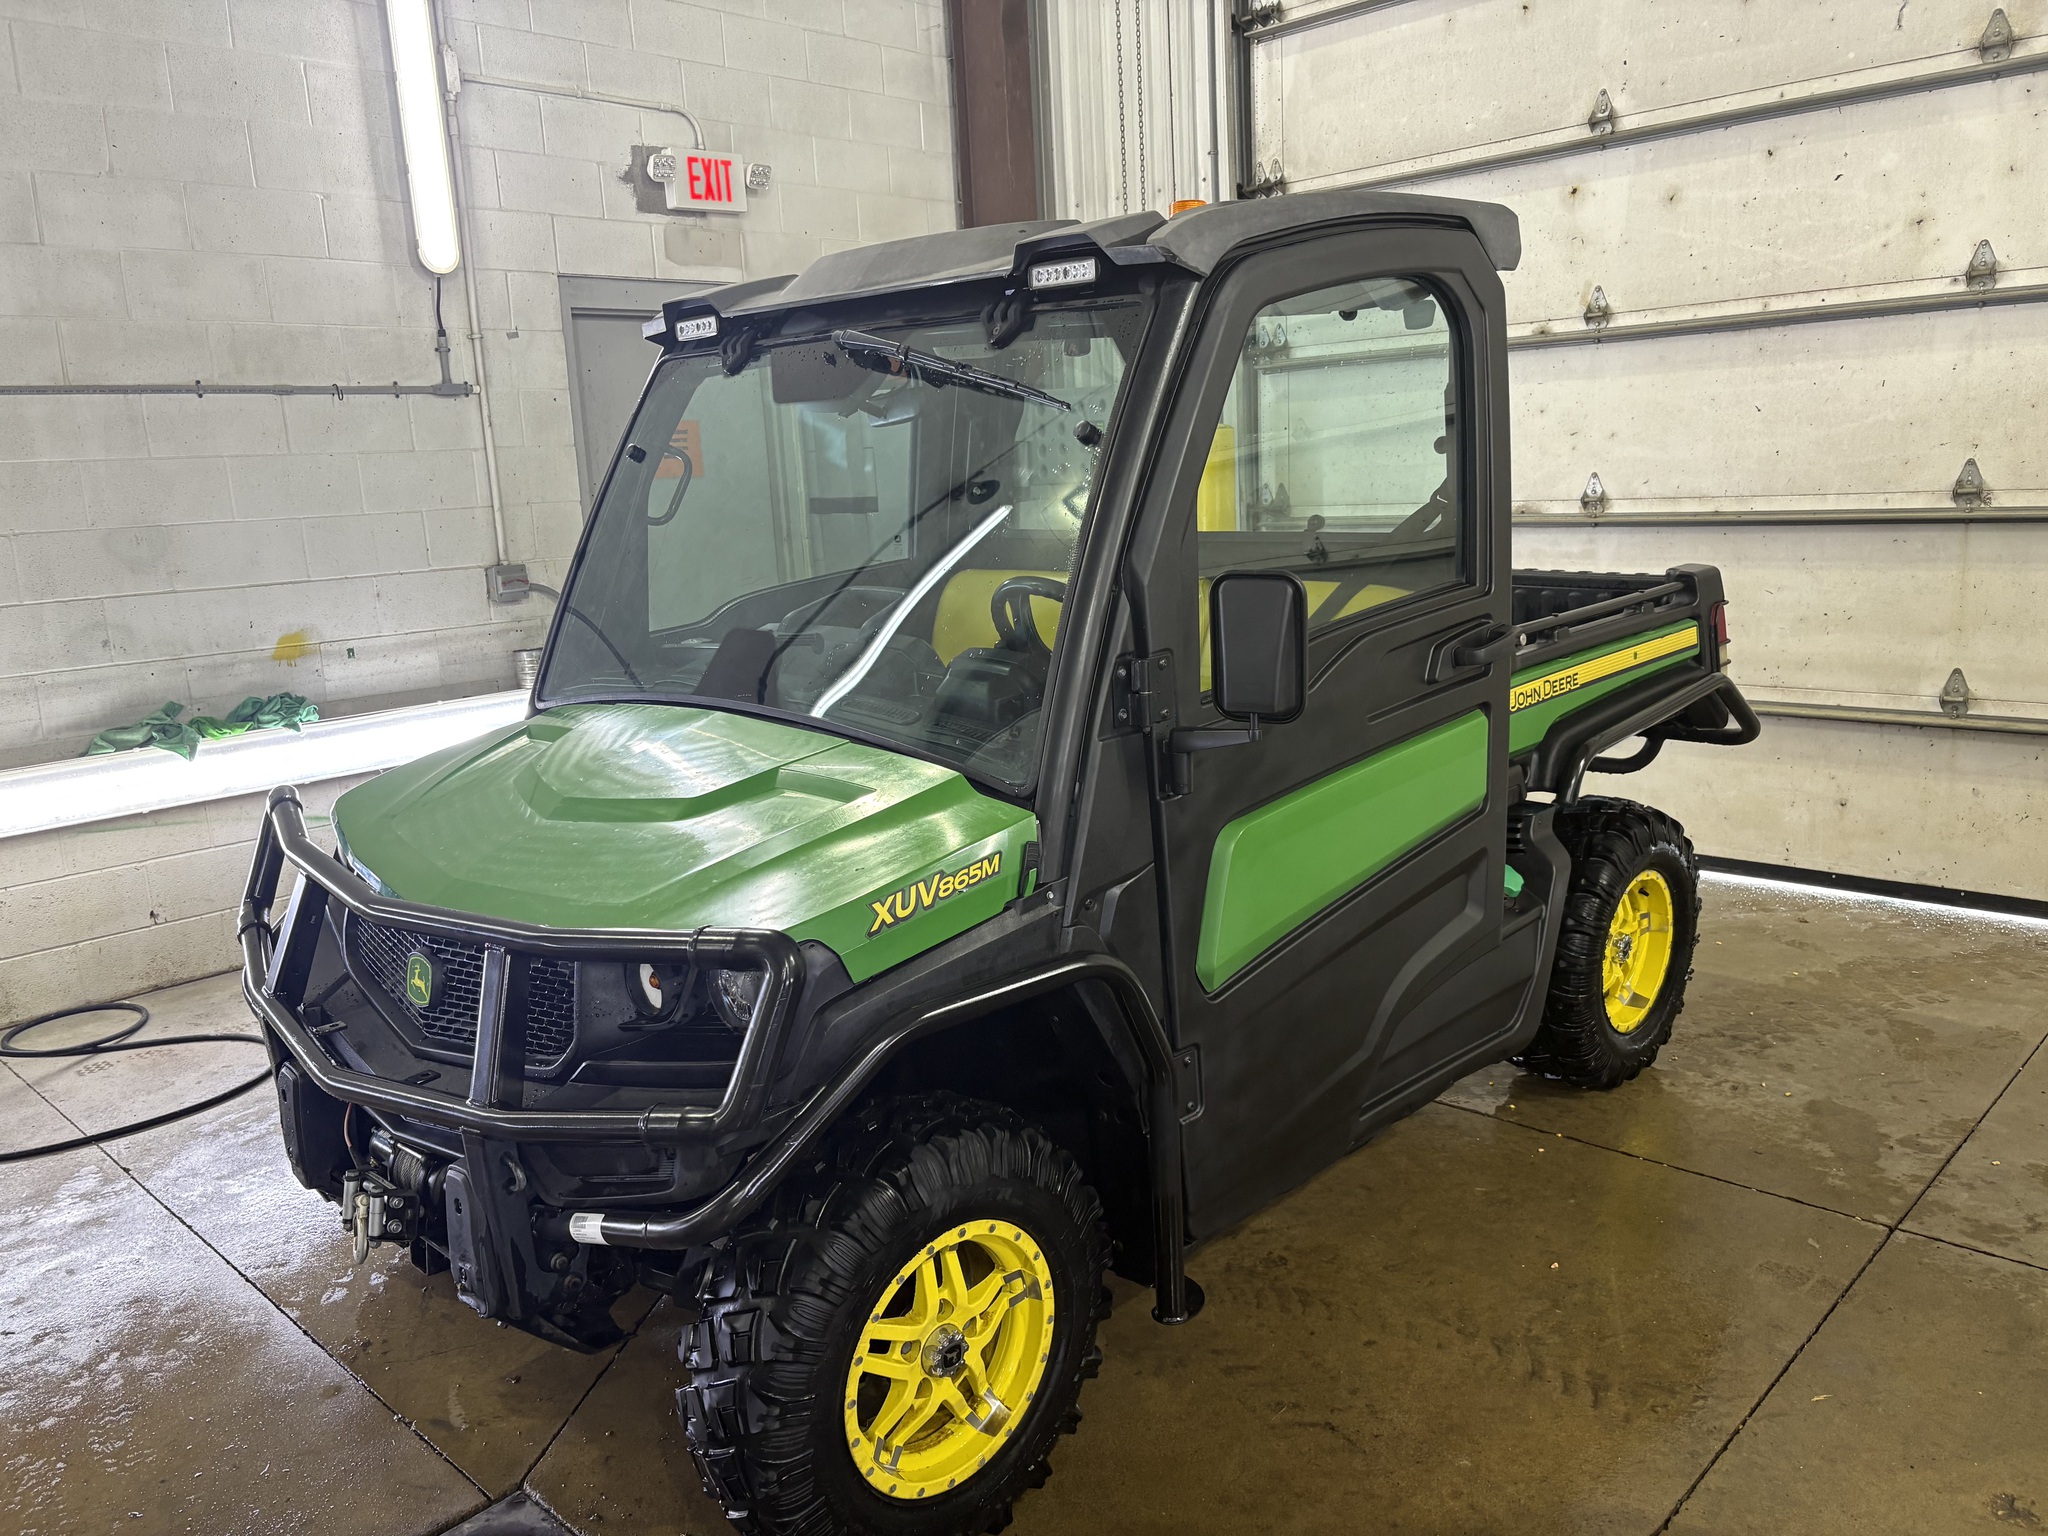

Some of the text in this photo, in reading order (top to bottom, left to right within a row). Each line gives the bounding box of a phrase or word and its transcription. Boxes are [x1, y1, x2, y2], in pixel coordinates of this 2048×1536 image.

[687, 156, 733, 203] EXIT
[1510, 672, 1579, 710] JOHN DEERE
[869, 853, 1001, 934] XUV865M
